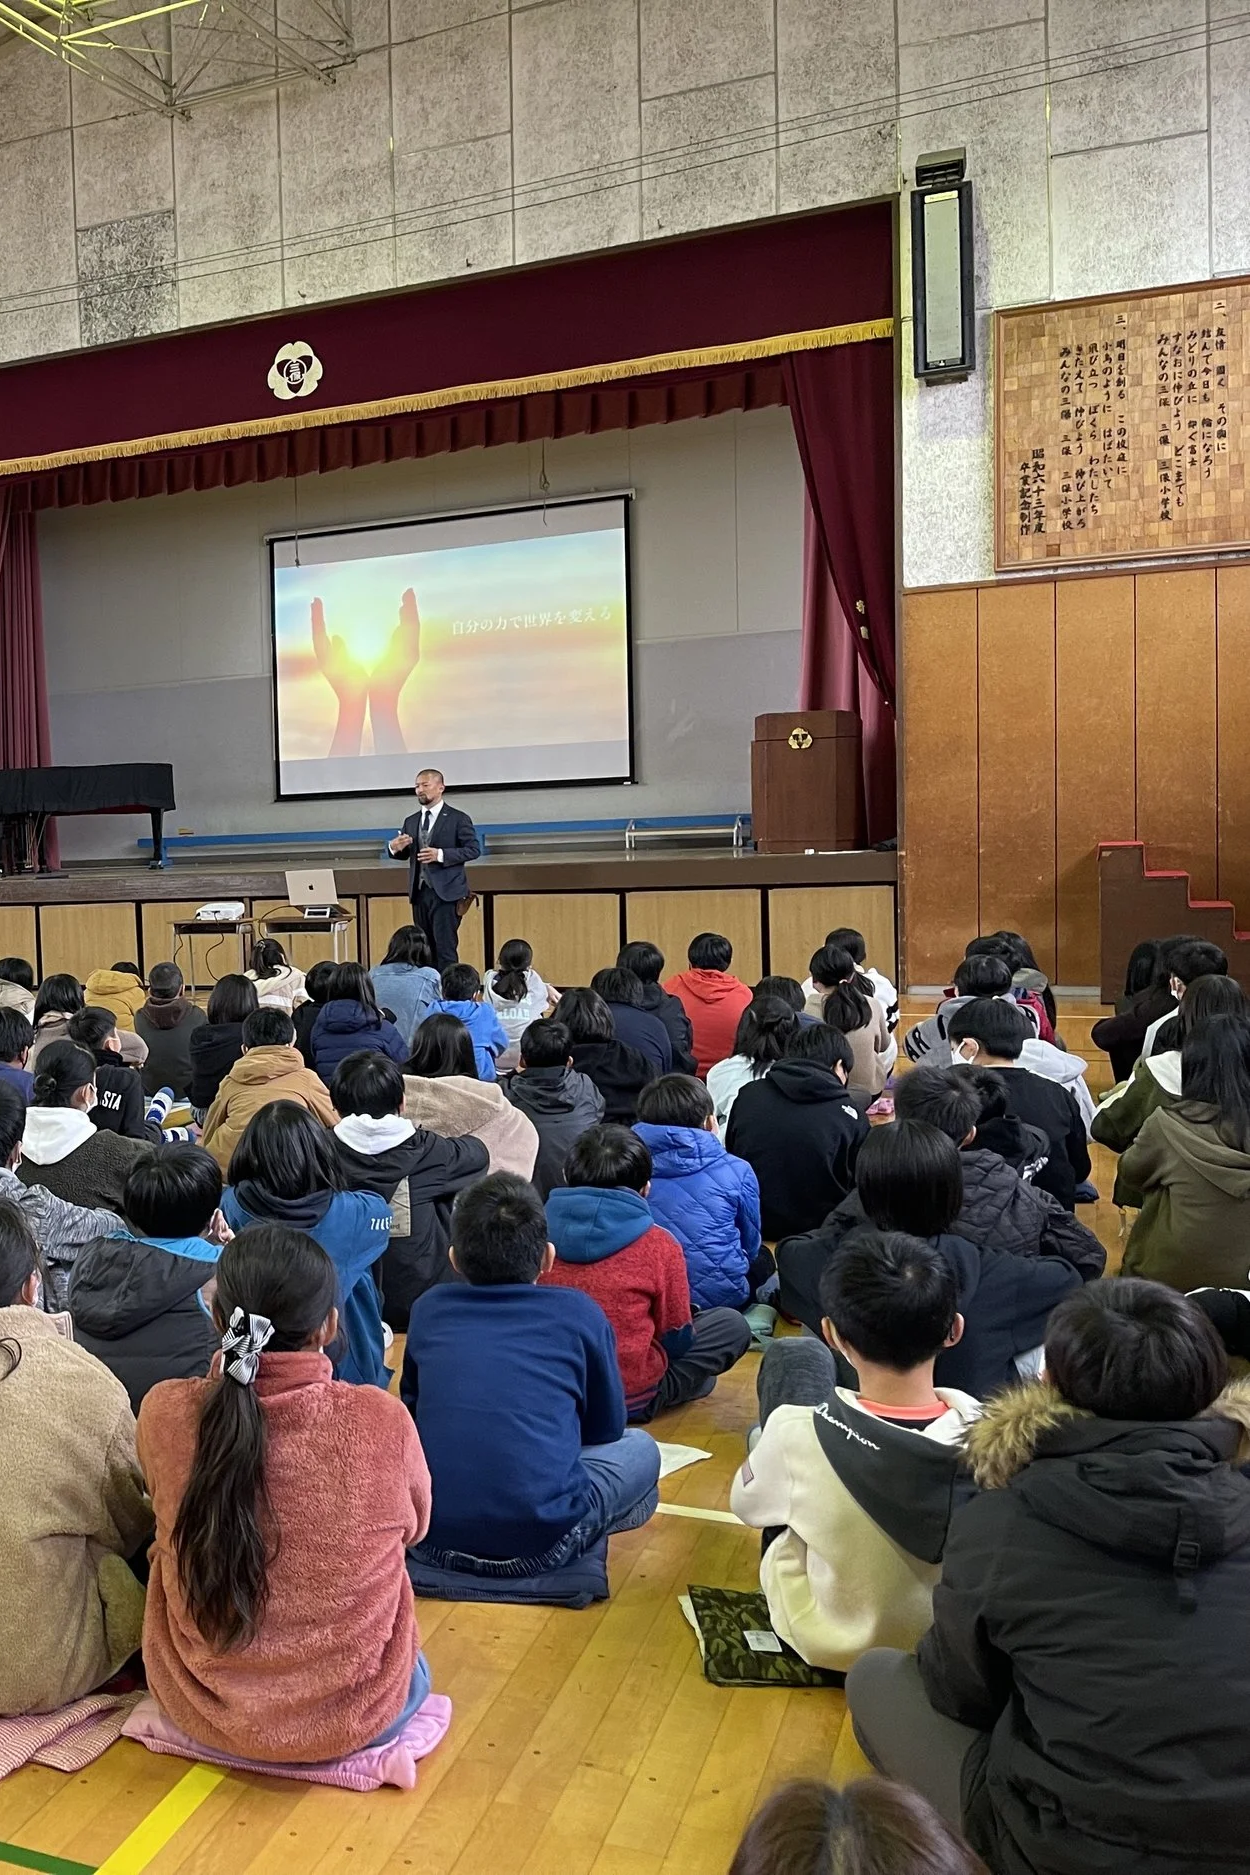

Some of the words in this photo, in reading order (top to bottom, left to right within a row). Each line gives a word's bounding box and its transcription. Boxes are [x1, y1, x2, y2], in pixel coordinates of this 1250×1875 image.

[1088, 343, 1099, 388] 飛び立つ
[1187, 329, 1198, 403] みどりの丘に
[1215, 328, 1226, 350] 友情
[1059, 347, 1071, 421] みんなの三保
[1102, 342, 1113, 414] 小鳥のように
[1116, 340, 1127, 400] 明日を創る
[1157, 334, 1170, 407] みんなの三保
[1172, 333, 1183, 431] すなおに伸びよう
[1060, 434, 1072, 456] 三保
[1074, 407, 1085, 455] 伸びよう
[1089, 404, 1100, 440] ぼくら
[1117, 414, 1128, 475] この校庭に
[1159, 423, 1170, 445] 三保
[1202, 417, 1213, 479] 輪になろう
[1089, 456, 1100, 515] わたしたち
[1103, 428, 1113, 490] はばたいて
[1032, 448, 1046, 534] 昭和六十三年度
[1061, 471, 1074, 530] 三保小学校
[1159, 460, 1172, 521] 三保小学校
[452, 606, 611, 635] 自分の力で世界を変える
[814, 1402, 881, 1451] Champion
